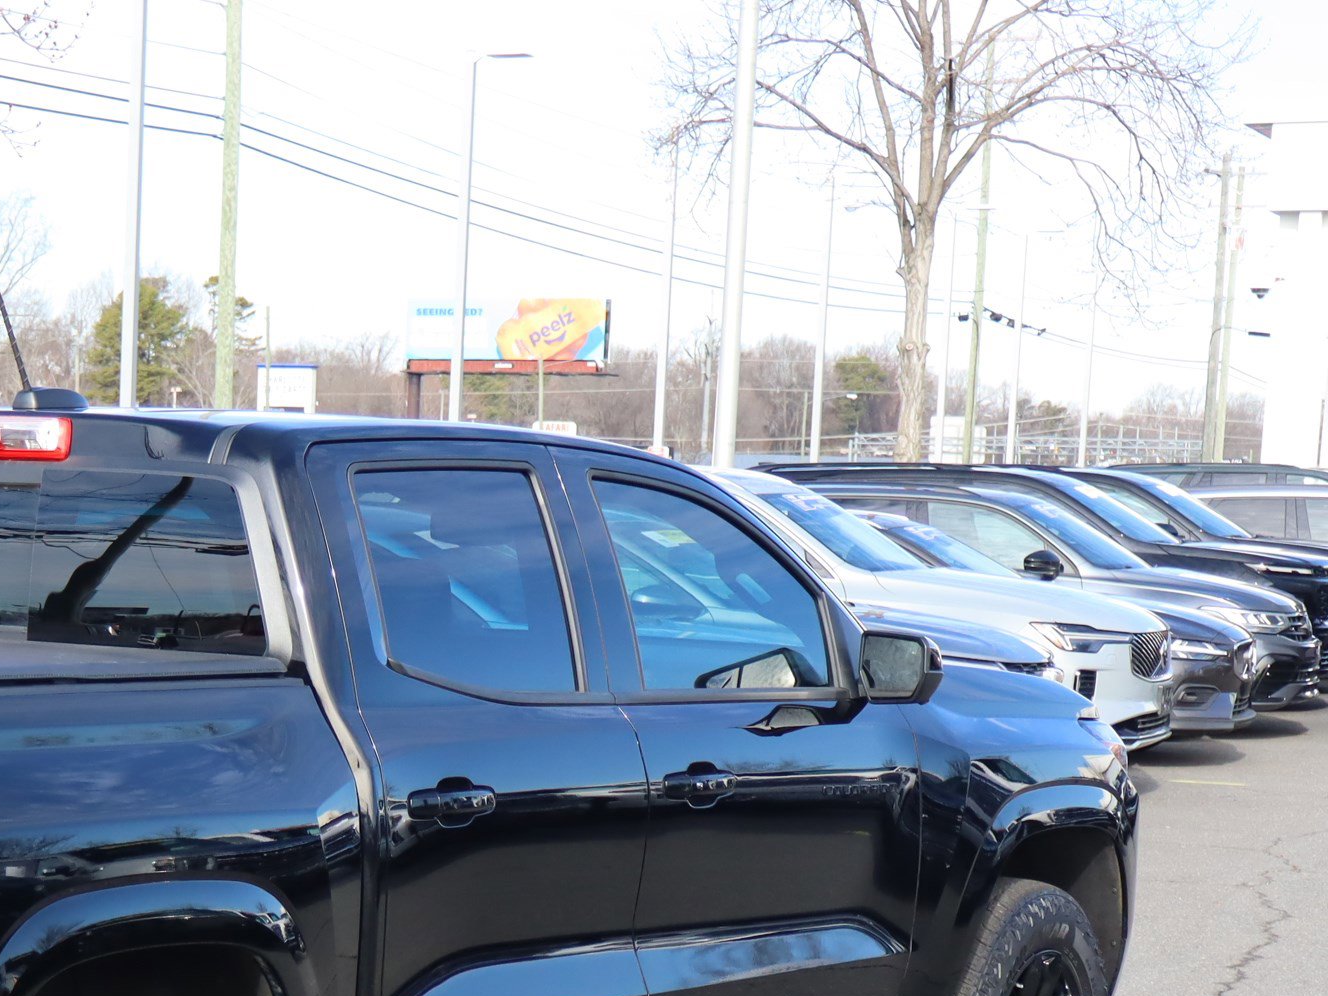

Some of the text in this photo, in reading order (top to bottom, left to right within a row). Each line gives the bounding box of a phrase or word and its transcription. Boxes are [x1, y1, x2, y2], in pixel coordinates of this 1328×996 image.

[416, 307, 483, 317] SEEING ED?
[540, 423, 570, 433] AFARI
